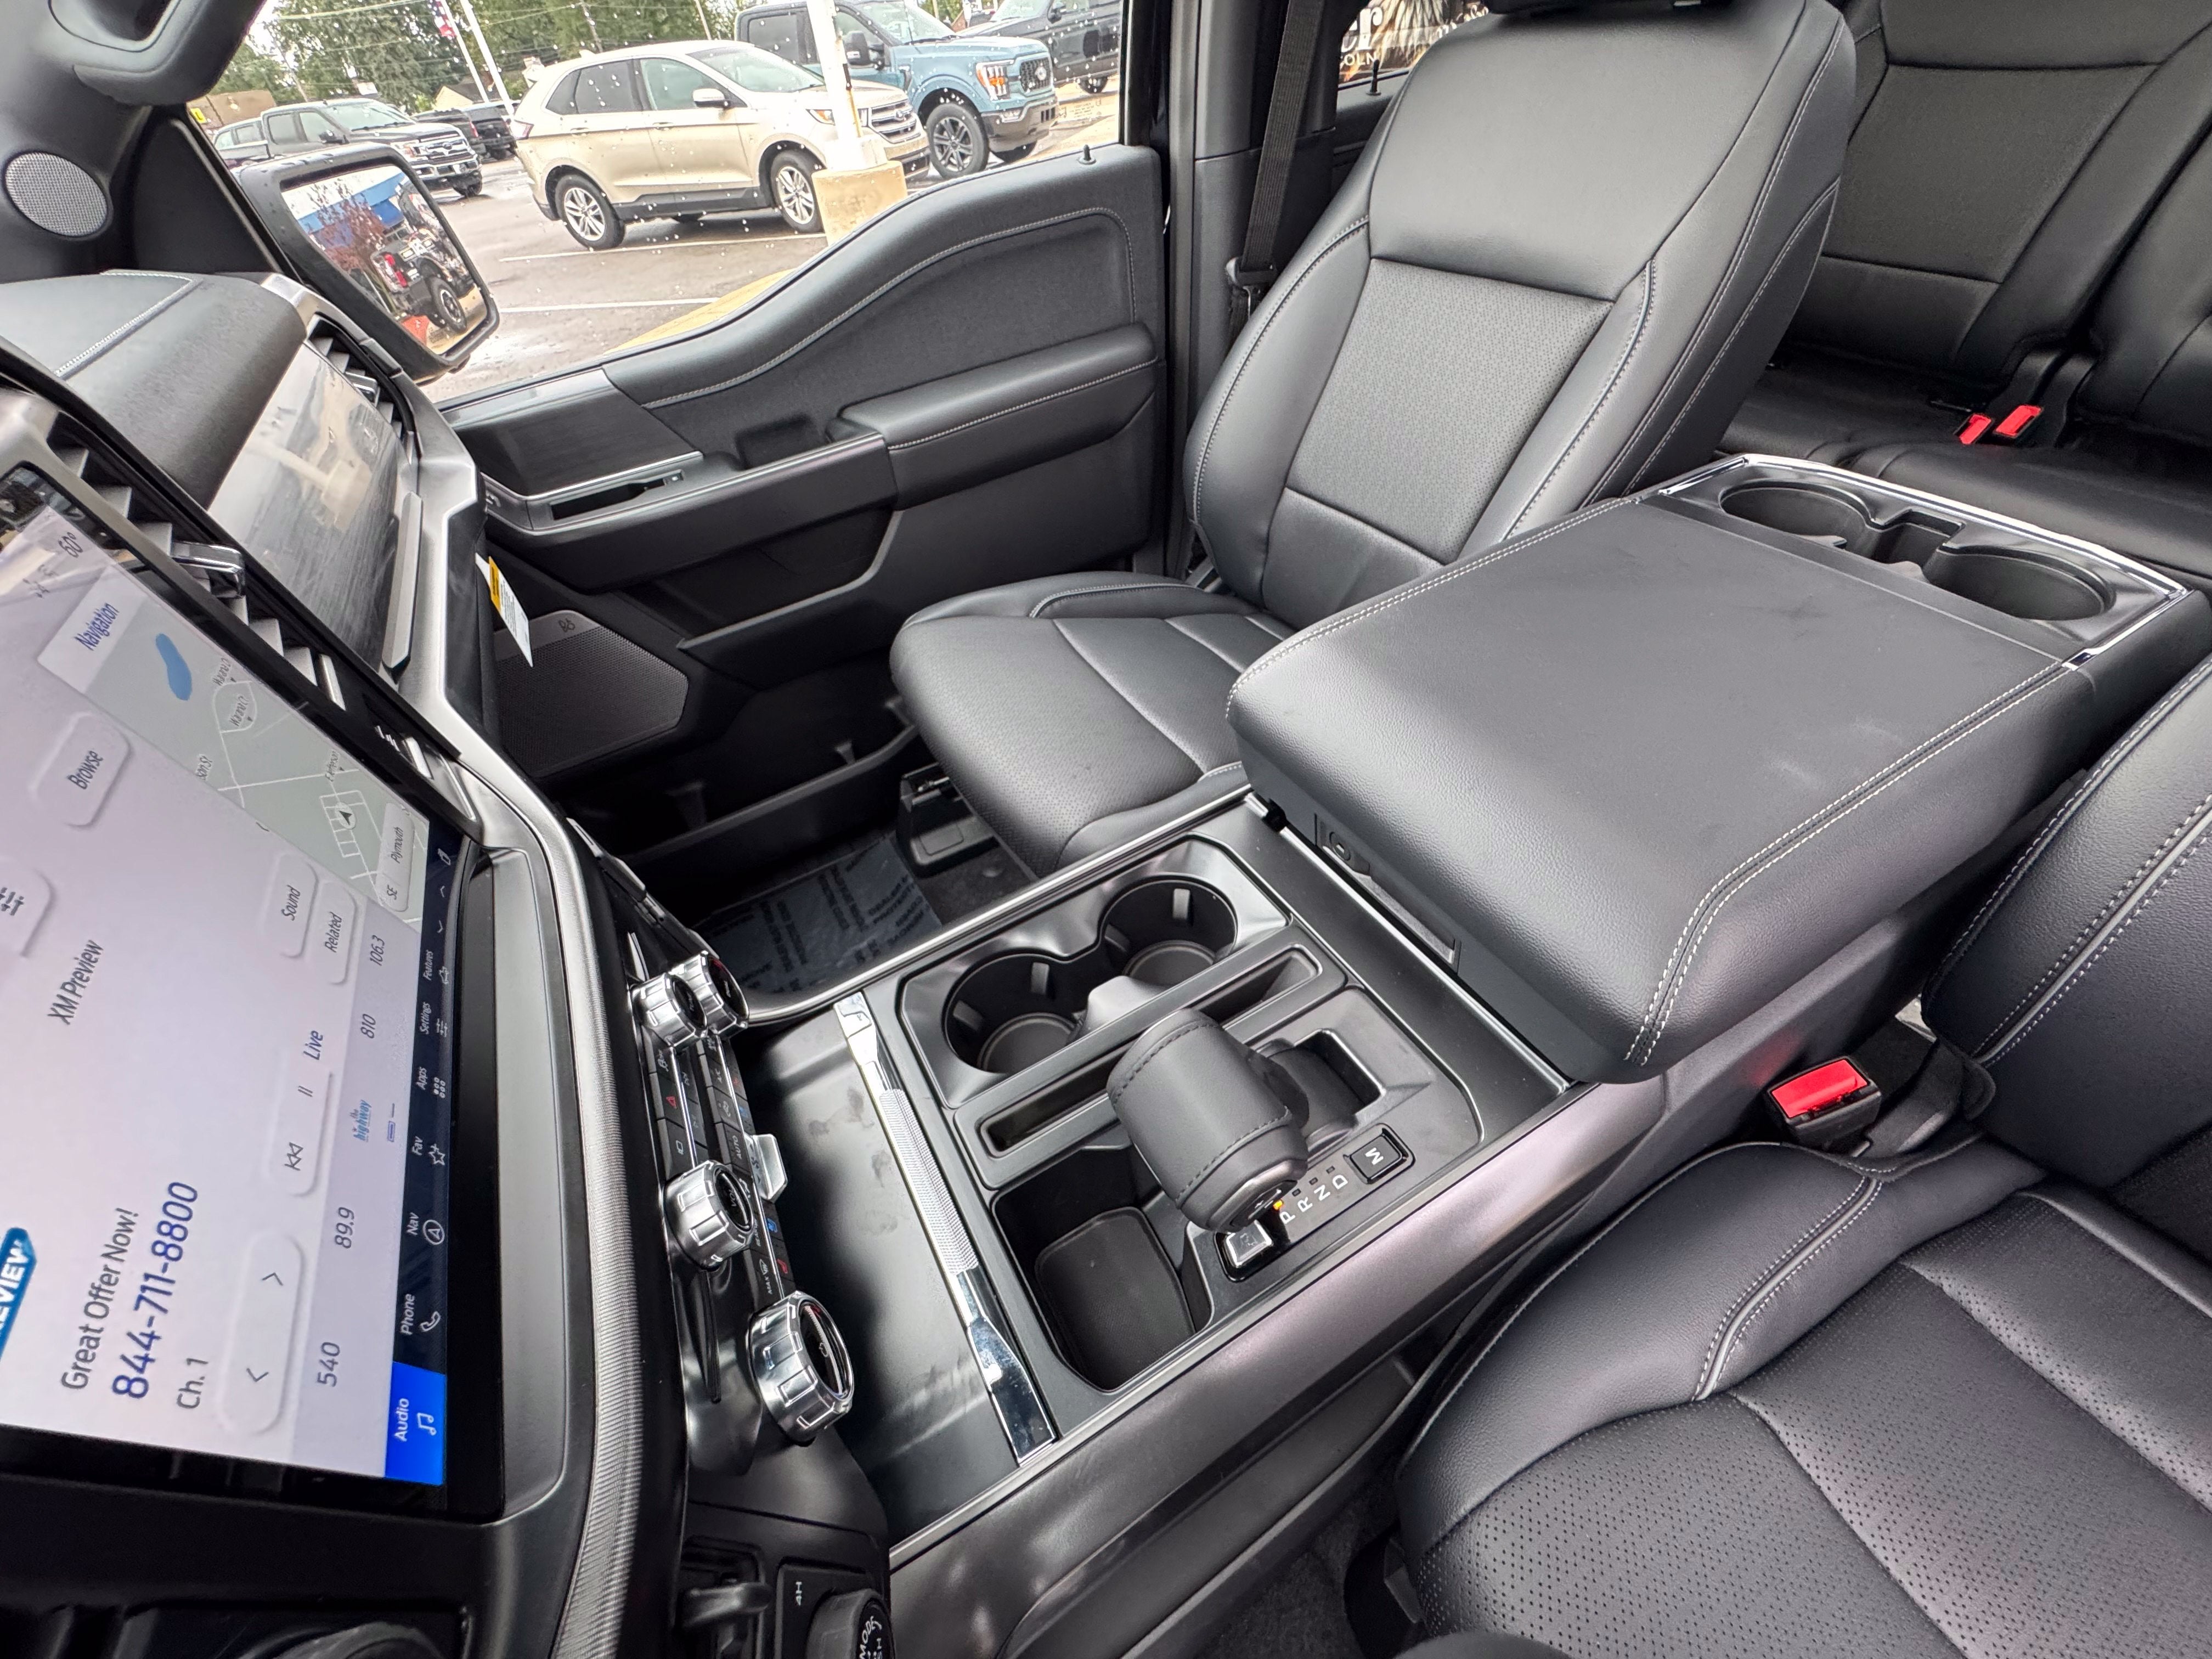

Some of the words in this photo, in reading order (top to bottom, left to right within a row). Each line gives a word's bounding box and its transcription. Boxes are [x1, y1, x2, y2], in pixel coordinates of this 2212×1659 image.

[1340, 51, 1378, 66] OLN
[73, 602, 120, 651] Navigation
[66, 748, 104, 792] Browse
[391, 826, 404, 864] Plymouth
[280, 885, 301, 922] Sound
[323, 911, 344, 953] Related
[59, 939, 104, 998] Preview
[369, 935, 386, 967] 106.3
[423, 950, 435, 981] Features
[47, 994, 80, 1025] XM
[360, 1014, 376, 1040] 810
[419, 1002, 432, 1034] Settings
[303, 1030, 324, 1062] Live
[415, 1066, 427, 1090] Apps
[353, 1099, 372, 1142] highway
[412, 1136, 424, 1156] Fav
[732, 1135, 742, 1159] AUTO
[1365, 1147, 1384, 1165] M
[1279, 1211, 1296, 1224] P
[1297, 1197, 1313, 1212] R
[1313, 1184, 1330, 1201] N
[1332, 1174, 1348, 1189] D
[100, 1208, 139, 1263] Now!
[334, 1206, 356, 1250] 89.9
[407, 1212, 420, 1235] Nav
[83, 1264, 121, 1320] Offer
[111, 1182, 198, 1400] 844-711-8800
[399, 1293, 415, 1335] Phone
[61, 1323, 104, 1391] Great
[185, 1358, 209, 1367] 1
[317, 1341, 342, 1388] 540
[177, 1375, 206, 1410] Ch.
[394, 1397, 410, 1442] Audio
[795, 1581, 803, 1606] 4H
